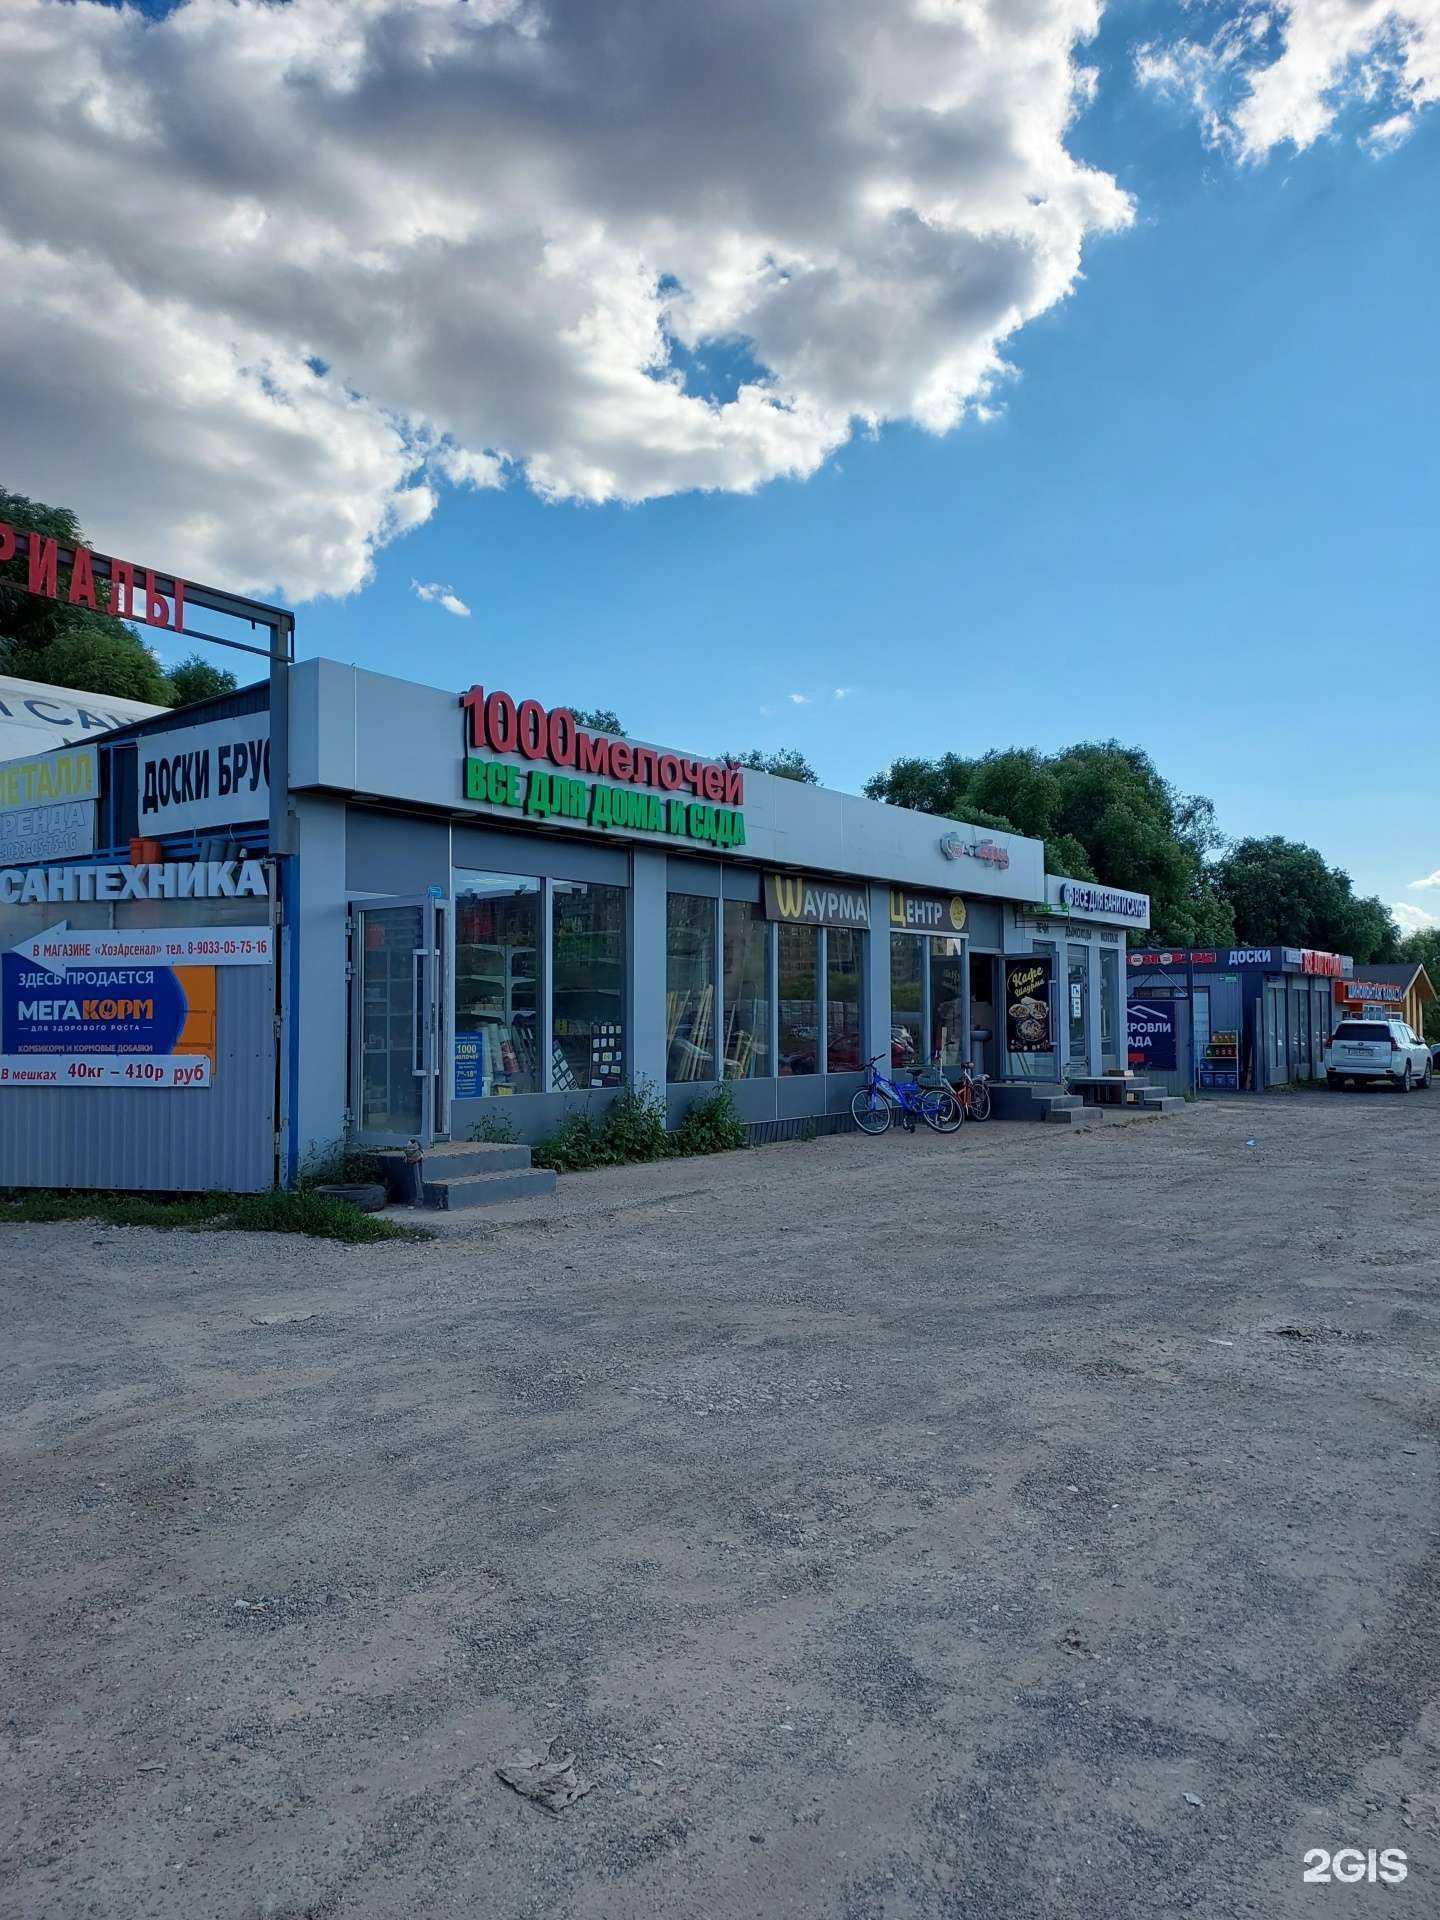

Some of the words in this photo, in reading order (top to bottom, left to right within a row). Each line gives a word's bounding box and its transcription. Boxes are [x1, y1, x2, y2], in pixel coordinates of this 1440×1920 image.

[143, 749, 209, 814] ДОСКИ
[463, 757, 521, 806] ВСЕ
[523, 769, 588, 819] ДЛЯ
[588, 784, 665, 832] ДОМА
[667, 798, 687, 835] И
[687, 802, 746, 849] САДА
[0, 860, 268, 904] САНТЕХНИКА
[890, 890, 943, 927] ЦЕНТР
[33, 946, 40, 956] В
[43, 944, 91, 957] МАГАЗИНЕ
[95, 941, 162, 957] «ХозАрсенал»
[165, 942, 184, 955] тел.
[188, 940, 268, 955] 8-9033-05-75-16
[1228, 949, 1272, 966] ДОСКИ
[18, 972, 62, 988] ЗДЕСЬ
[66, 970, 154, 987] ПРОДАЕТСЯ
[52, 1024, 107, 1032] ЗДОРОВОГО
[18, 1045, 65, 1053] КОМБИКОРМ
[73, 1044, 116, 1052] КОРМОВЫЕ
[117, 1044, 153, 1053] ДОБАВКИ
[1, 1068, 9, 1079] В
[12, 1069, 57, 1081] мешках
[67, 1063, 105, 1079] 40кг
[125, 1063, 164, 1082] 410р
[173, 1063, 204, 1086] руб
